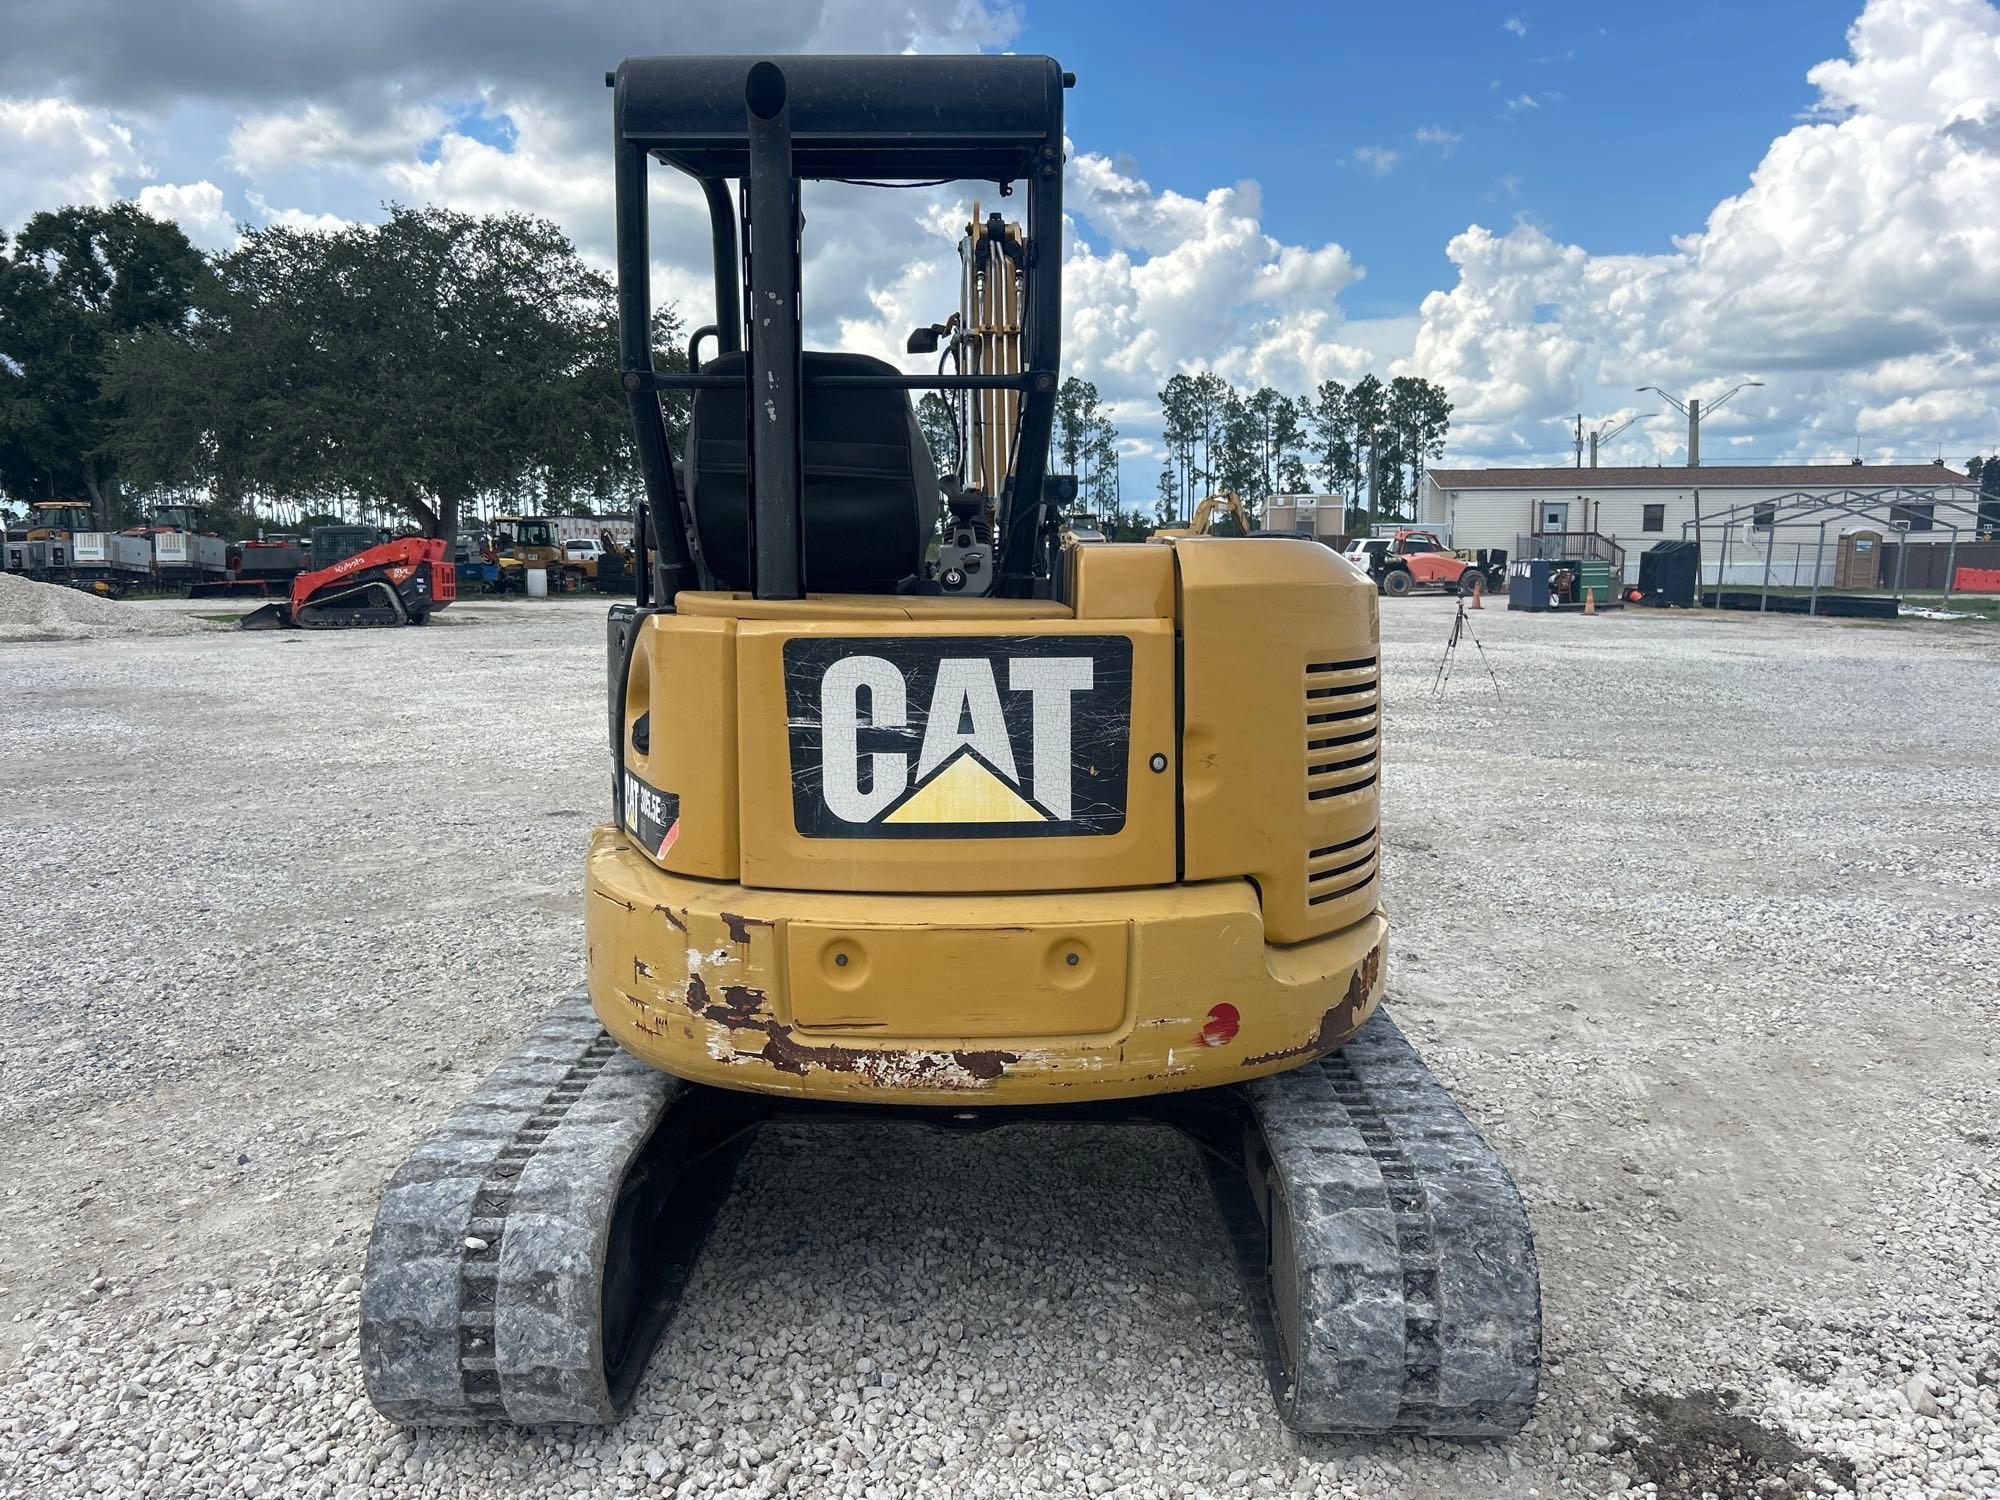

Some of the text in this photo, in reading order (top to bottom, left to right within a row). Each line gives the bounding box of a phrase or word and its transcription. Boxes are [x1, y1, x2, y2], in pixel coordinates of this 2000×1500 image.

[334, 557, 365, 573] Kubota
[528, 553, 539, 561] CAT
[821, 655, 1094, 823] CAT
